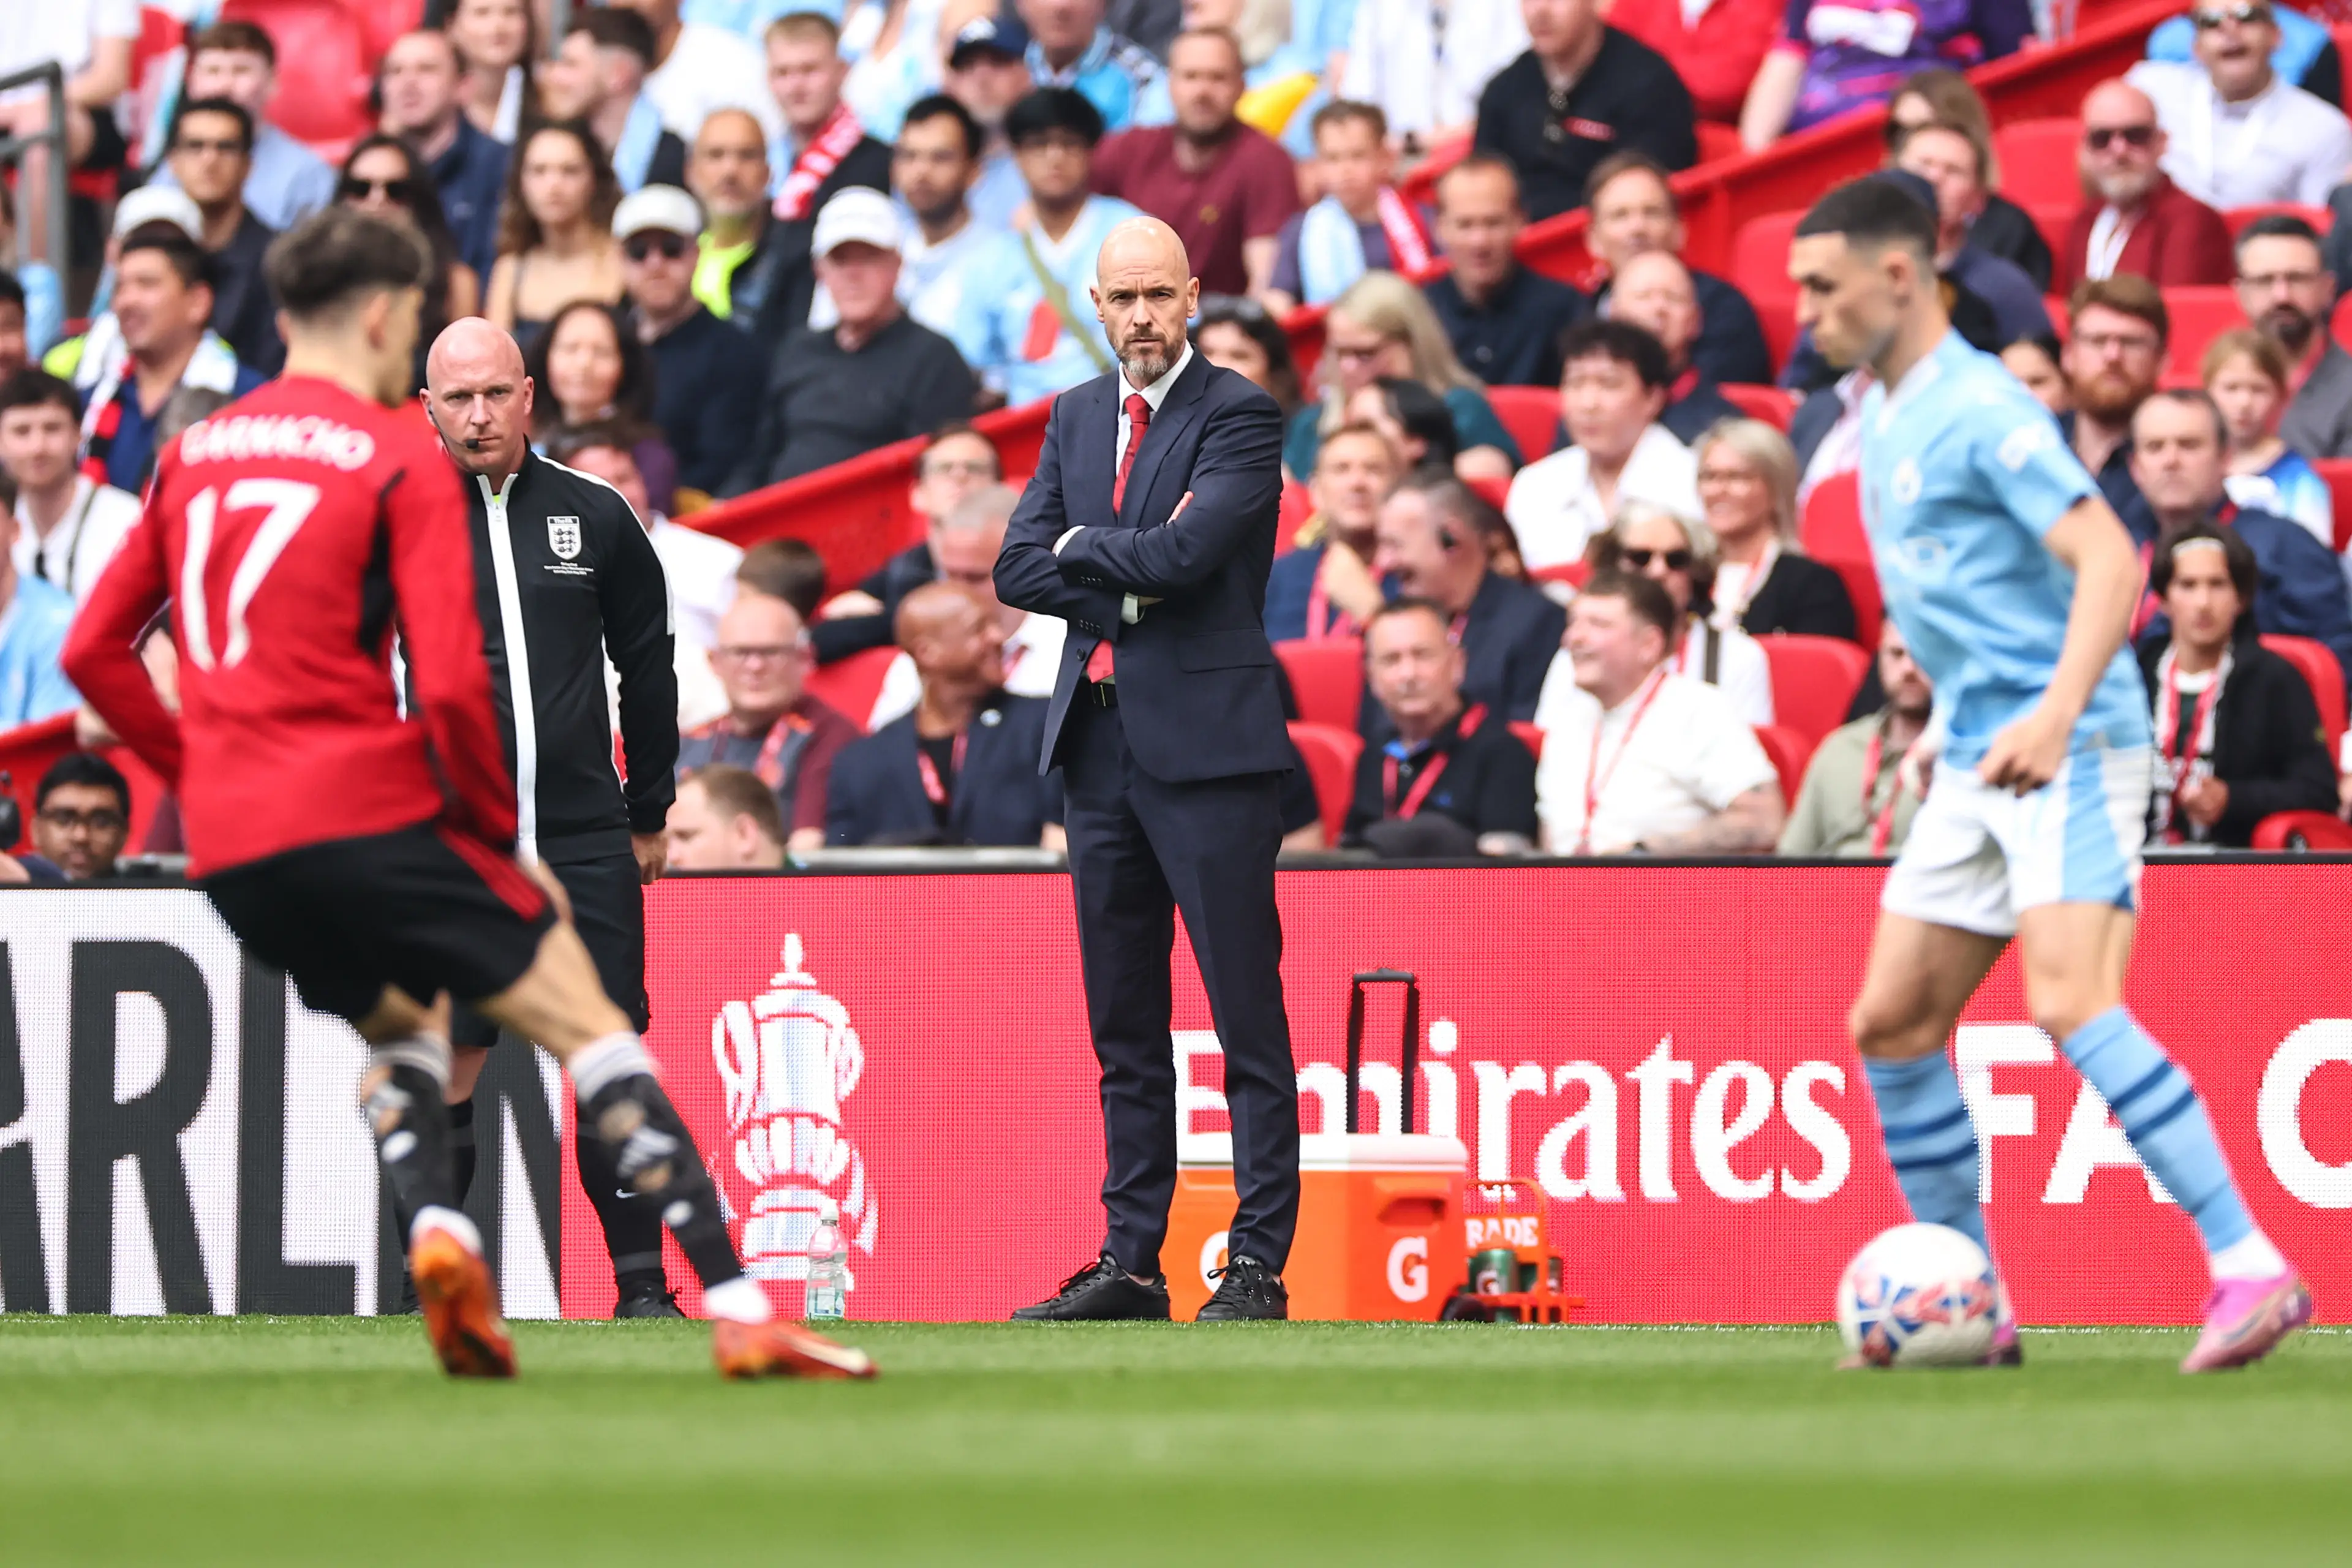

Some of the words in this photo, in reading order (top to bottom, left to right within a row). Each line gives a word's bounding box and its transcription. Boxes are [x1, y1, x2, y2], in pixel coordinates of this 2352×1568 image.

[180, 477, 323, 673] 17
[1956, 1021, 2177, 1203] FA
[1386, 1235, 1429, 1303] G
